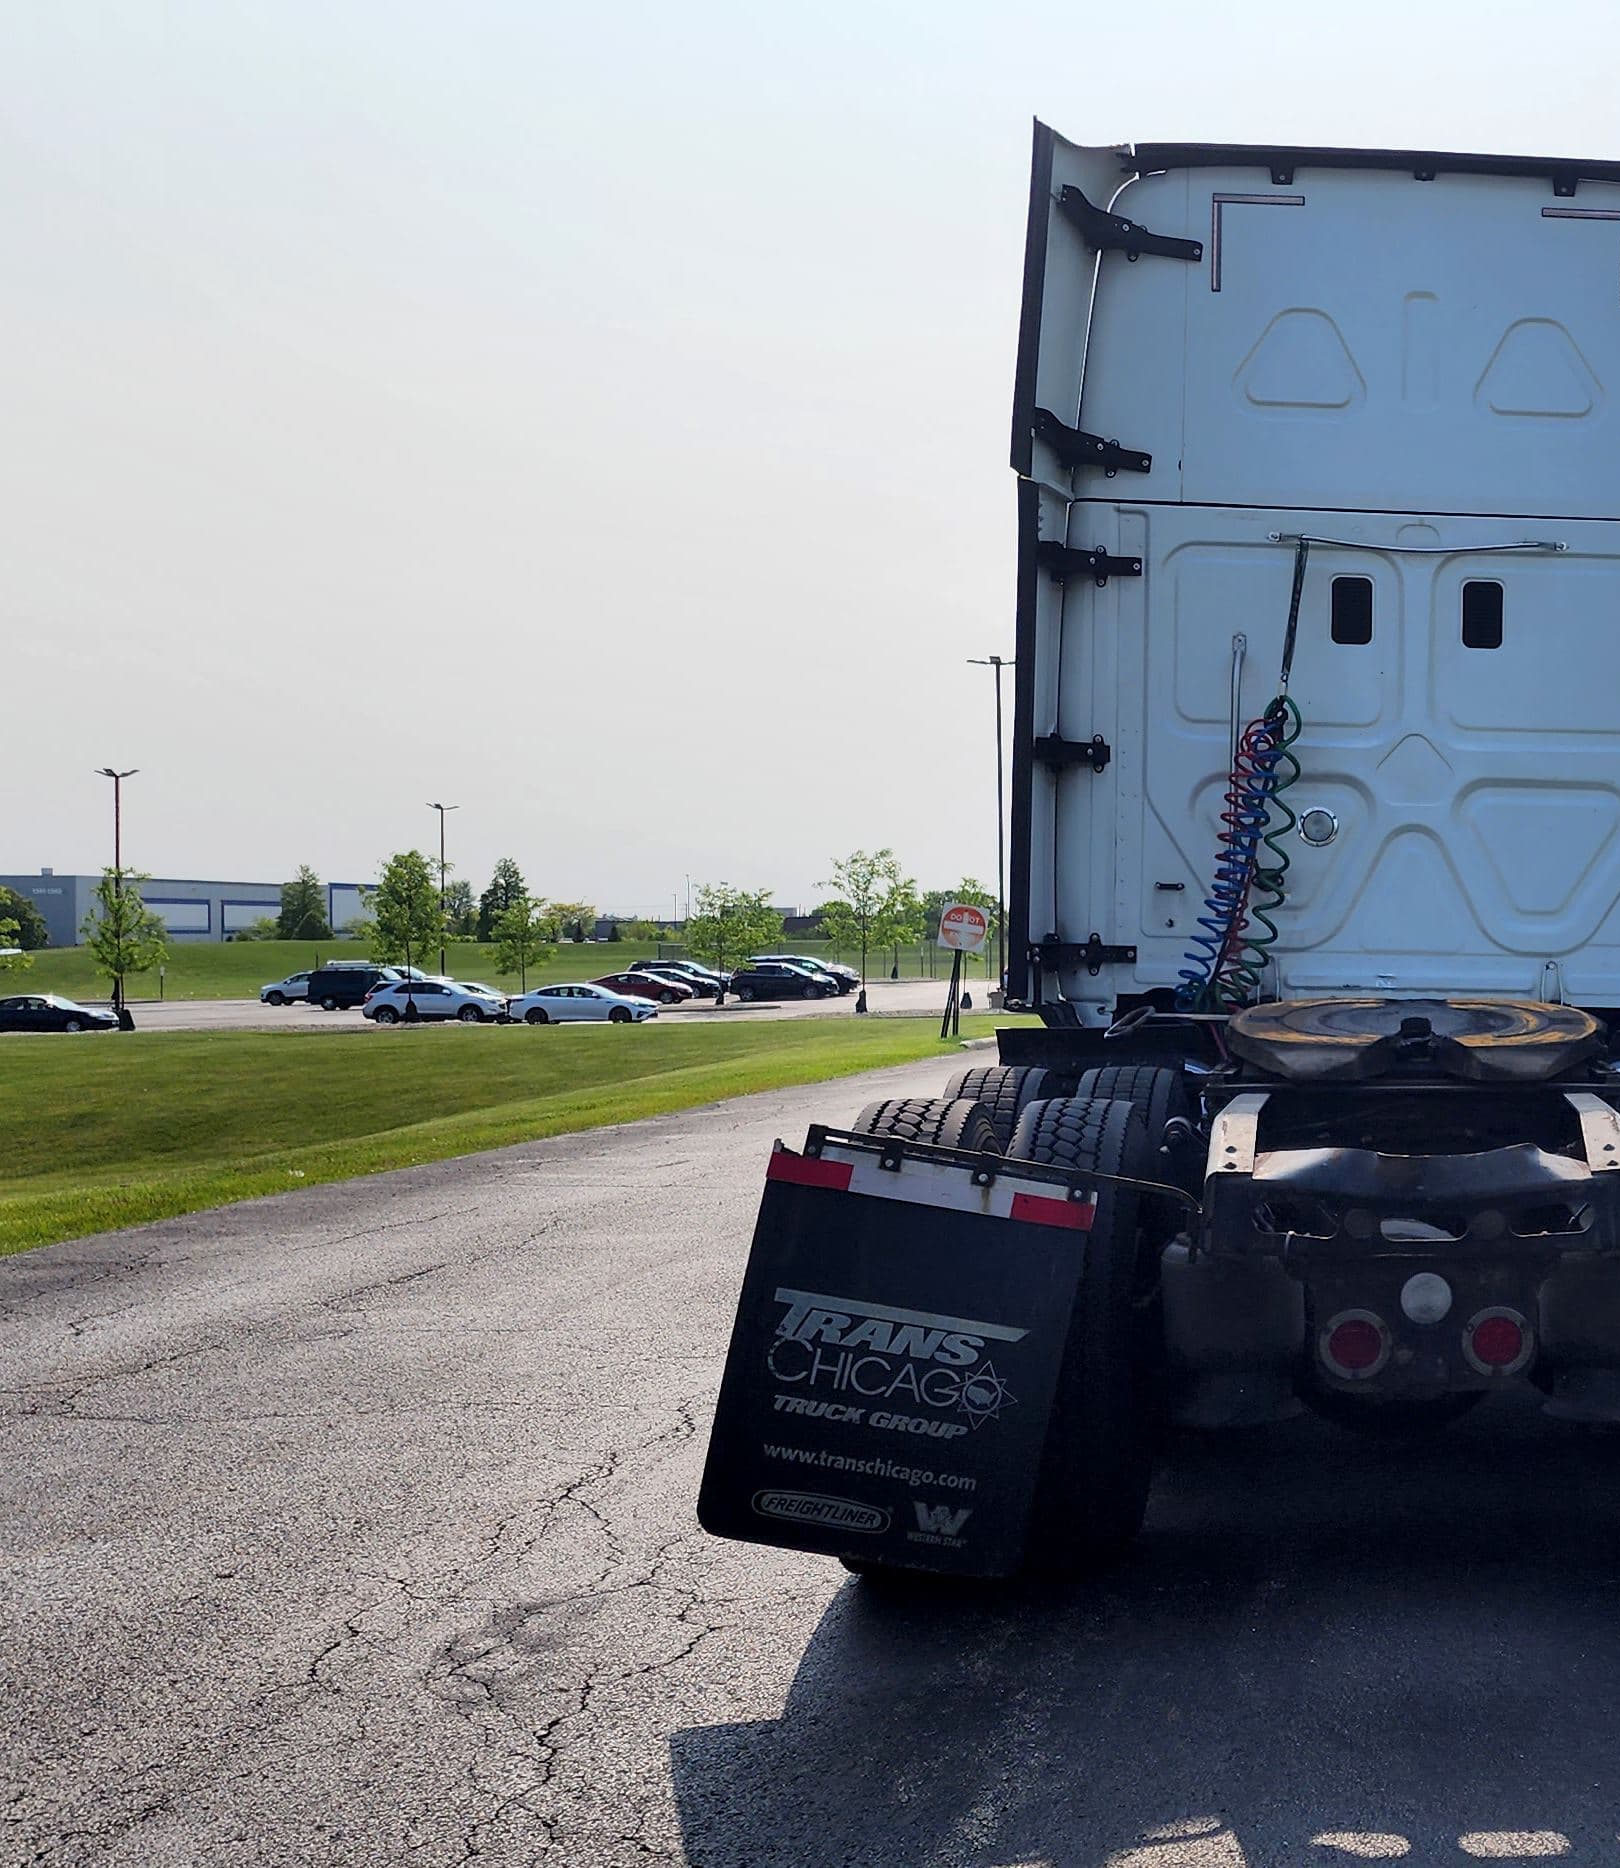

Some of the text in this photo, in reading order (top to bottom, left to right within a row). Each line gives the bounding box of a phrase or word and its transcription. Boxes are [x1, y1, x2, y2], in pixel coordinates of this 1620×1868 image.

[950, 913, 962, 921] DO
[774, 1288, 1031, 1367] TRANS
[767, 1338, 1004, 1418] CHICAGO
[772, 1394, 969, 1440] TRUCK GROUP
[763, 1442, 977, 1491] www.transchicago.com
[765, 1496, 877, 1528] FREIGHTLINER
